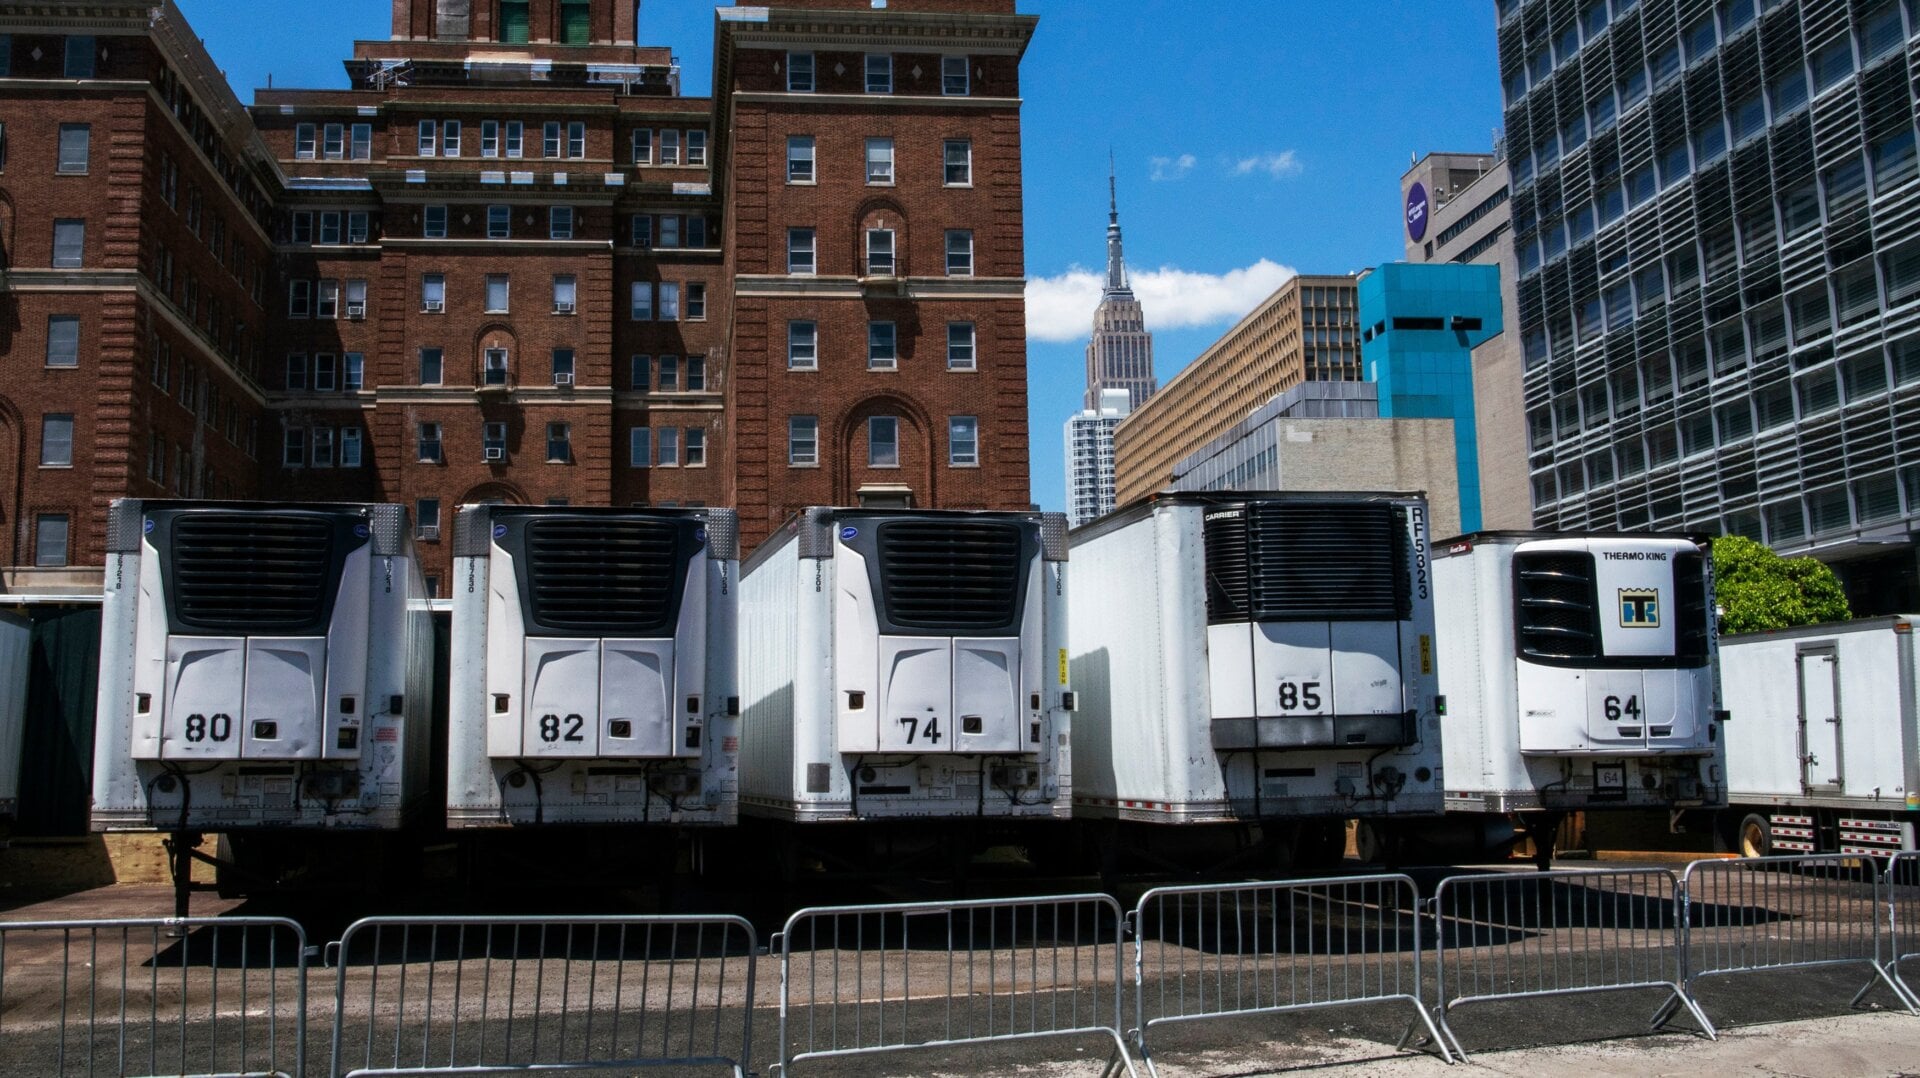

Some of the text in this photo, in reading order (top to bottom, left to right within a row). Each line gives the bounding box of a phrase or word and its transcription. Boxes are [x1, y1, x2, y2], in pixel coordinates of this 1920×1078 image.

[1205, 510, 1239, 522] CARRIER
[1412, 507, 1428, 600] RF5323
[1603, 552, 1667, 561] THERMO KING
[1706, 557, 1718, 654] RF48131
[1279, 682, 1321, 710] 85
[1604, 694, 1641, 721] 64
[185, 713, 231, 742] 80
[540, 714, 584, 742] 82
[900, 717, 942, 744] 74
[1604, 772, 1618, 784] 64
